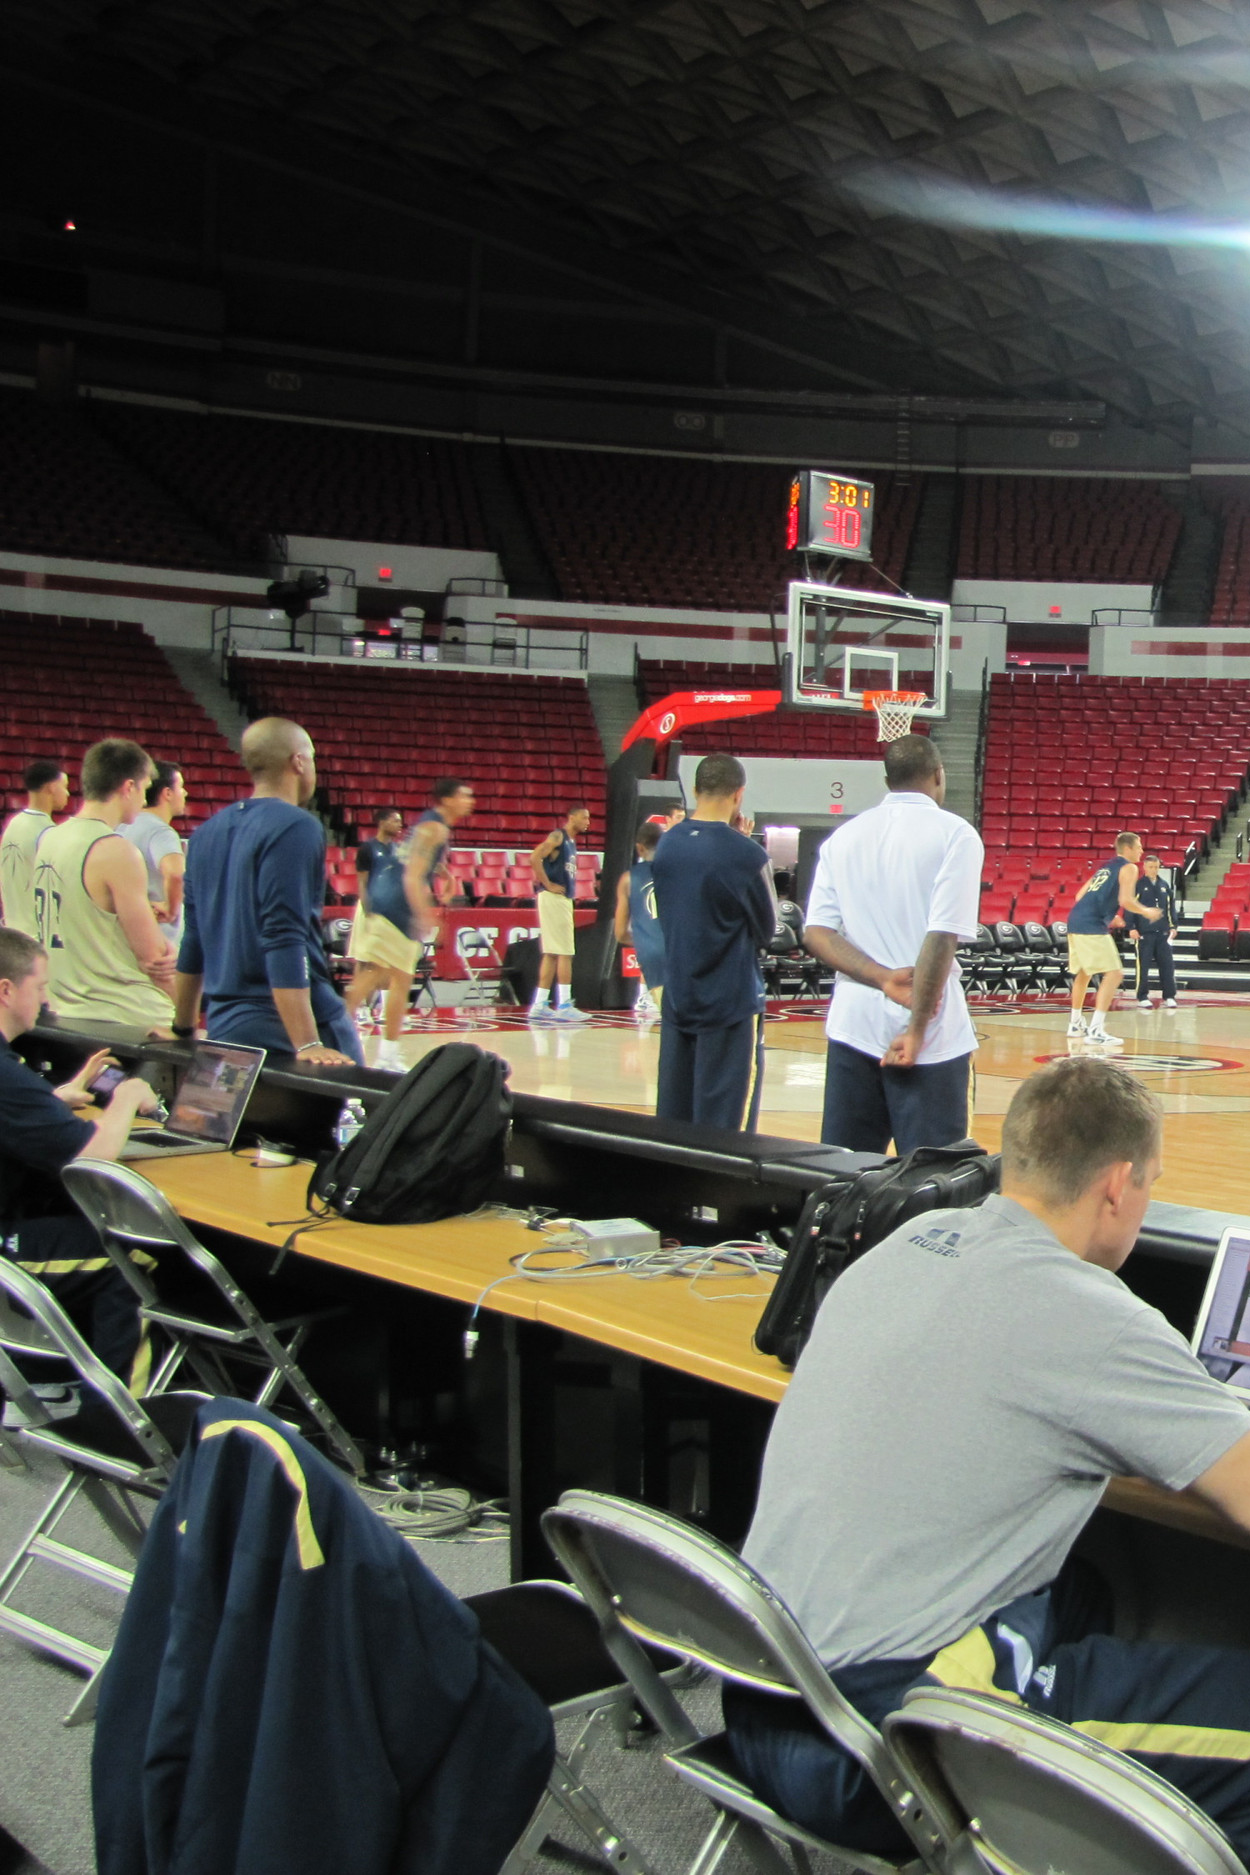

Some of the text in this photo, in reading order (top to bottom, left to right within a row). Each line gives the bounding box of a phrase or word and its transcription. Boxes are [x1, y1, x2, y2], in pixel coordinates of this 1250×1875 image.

[828, 481, 871, 509] 3:01
[822, 504, 861, 549] 30
[829, 781, 845, 799] 3
